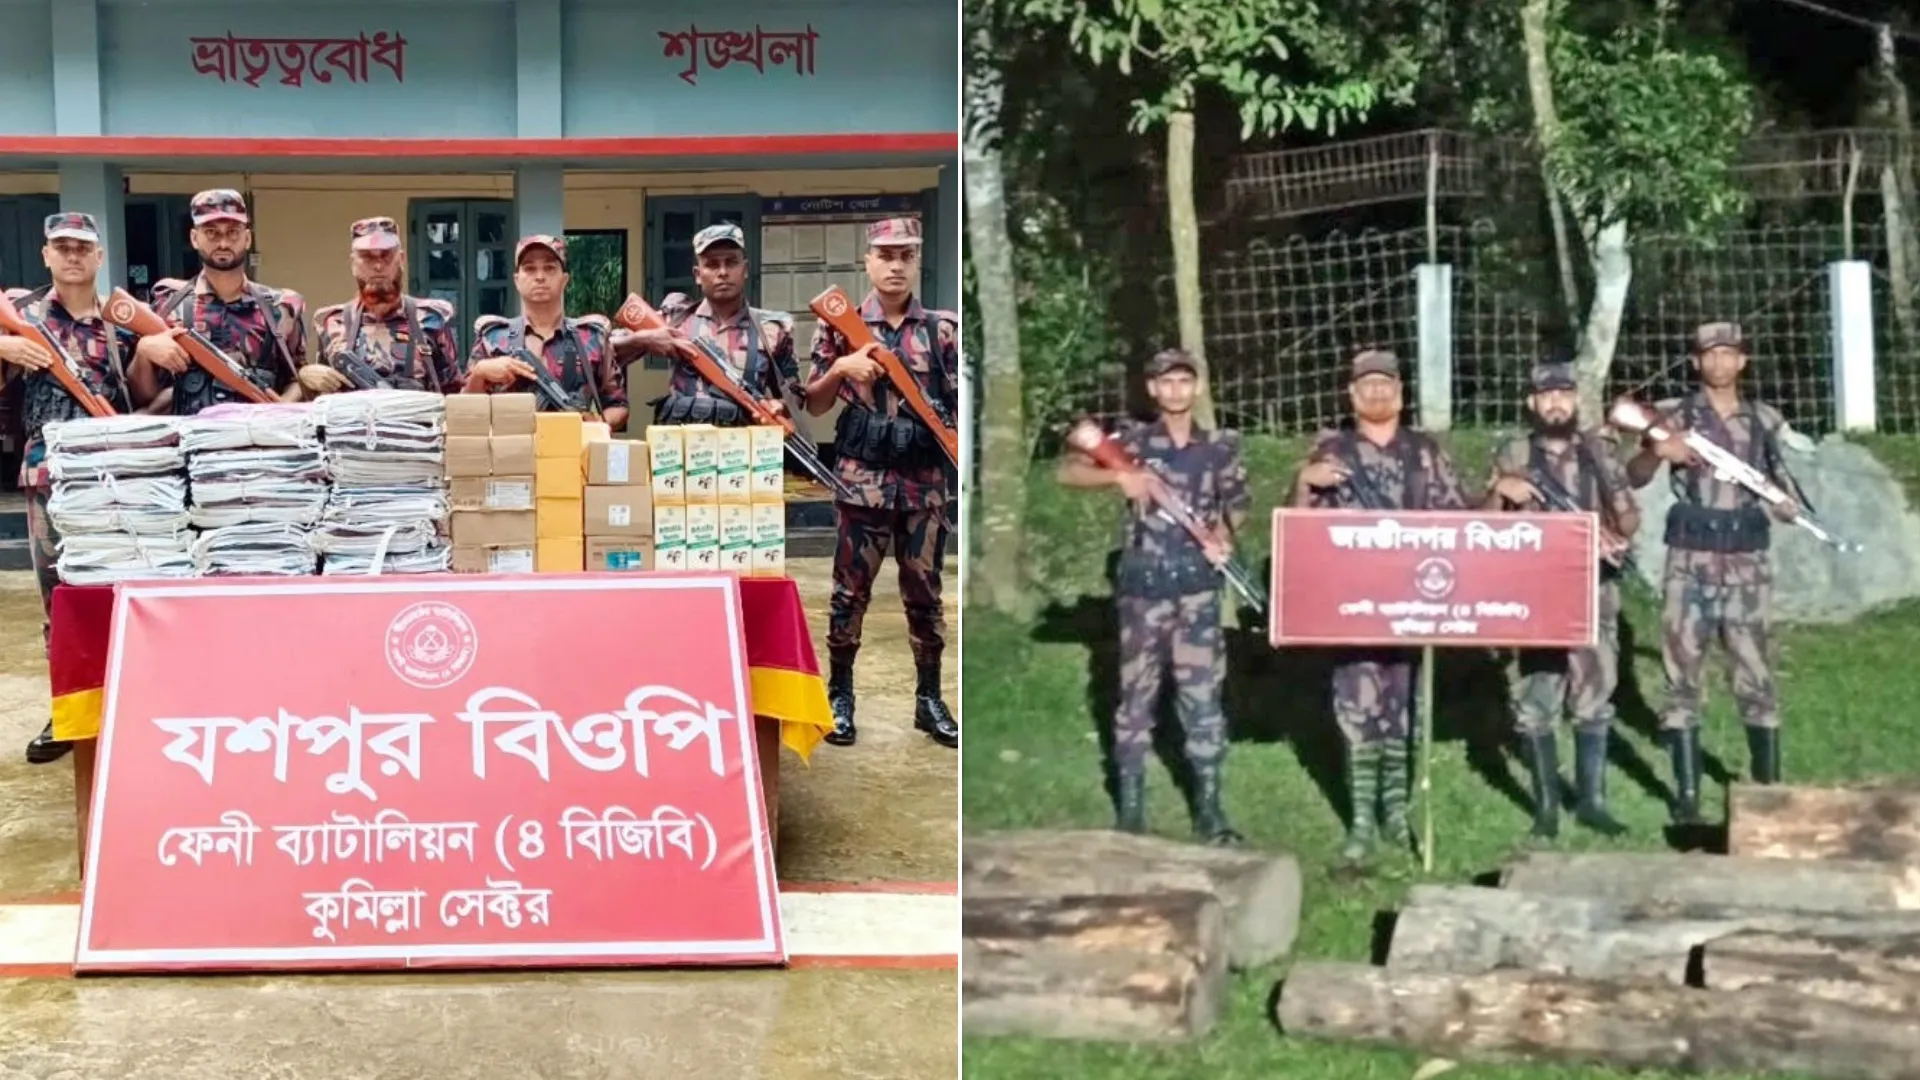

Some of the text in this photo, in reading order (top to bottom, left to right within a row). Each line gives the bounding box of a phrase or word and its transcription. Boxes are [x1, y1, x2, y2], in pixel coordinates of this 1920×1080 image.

[188, 29, 409, 88] ভ্রাতৃত্ববোধ
[657, 23, 821, 86] শৃঙ্খলা
[1464, 519, 1544, 551] বিওপি
[153, 685, 734, 801] যশপুর বিওপি
[157, 805, 718, 870] ফেনী ব্যাটালিয়ন (৪ বিজিবি)
[303, 876, 552, 943] কুমিল্লা সেক্টর
